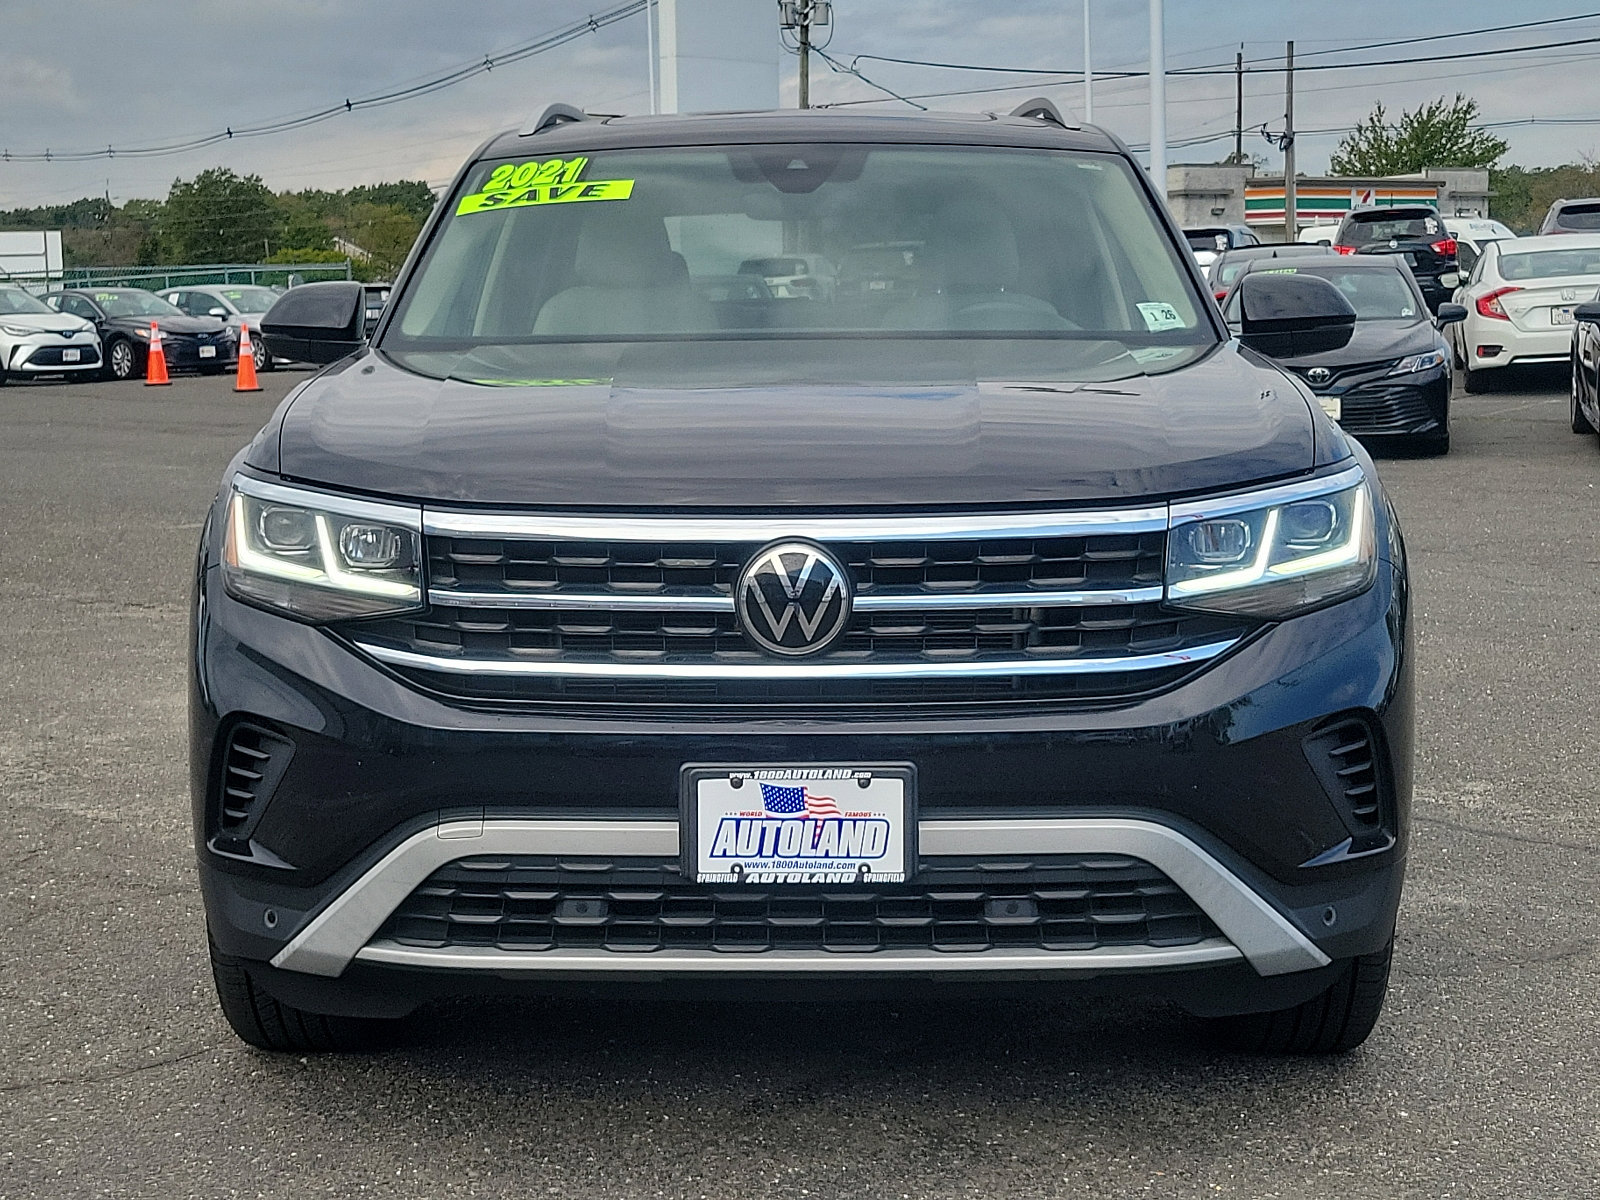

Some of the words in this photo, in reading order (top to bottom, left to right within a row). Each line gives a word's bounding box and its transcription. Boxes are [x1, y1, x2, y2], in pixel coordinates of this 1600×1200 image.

[482, 157, 588, 193] 2021
[478, 183, 611, 208] SAVE
[1161, 309, 1177, 320] 26
[709, 818, 890, 859] AUTOLAND
[744, 860, 856, 870] www.1800Autoland.com
[697, 873, 738, 884] SPRINGFIELD
[745, 872, 857, 884] AUTOLAND
[863, 873, 905, 883] SPRINGFIELD
